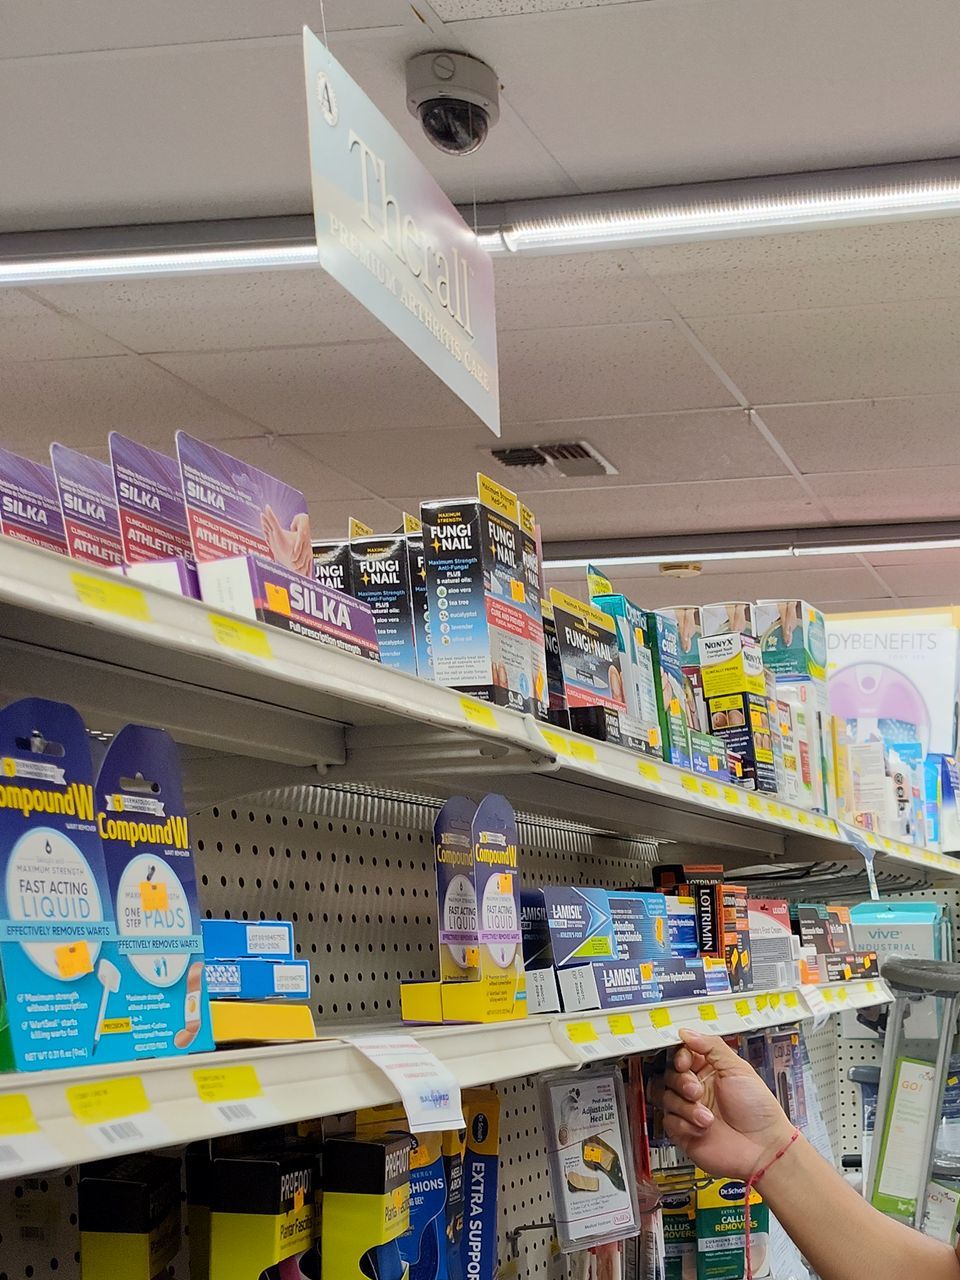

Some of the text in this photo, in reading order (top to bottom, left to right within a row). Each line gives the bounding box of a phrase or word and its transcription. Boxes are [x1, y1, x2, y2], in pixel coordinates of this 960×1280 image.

[349, 128, 475, 340] Therall
[328, 212, 491, 393] PREMIUM ARTHRITIS CARE
[119, 482, 162, 512] SILKA
[187, 481, 226, 511] SILKA
[2, 498, 48, 526] SILKA
[63, 492, 107, 523] SILKA
[430, 524, 472, 539] FUNGI
[488, 520, 516, 551] FUNGI
[127, 529, 184, 558] ATHLETE'S
[441, 537, 472, 552] NAIL
[360, 559, 400, 574] FUNGI
[496, 546, 517, 569] NAIL
[370, 571, 401, 585] NAIL
[289, 582, 353, 631] SILKA
[301, 626, 335, 647] prescription
[335, 637, 362, 656] strength
[565, 626, 613, 663] FUNGI NAIL
[17, 865, 85, 876] MAXIMUM STRENGTH
[19, 879, 88, 896] FAST ACTING
[21, 895, 91, 919] LIQUID
[125, 908, 141, 918] ONE
[497, 906, 513, 917] ACTING
[550, 904, 582, 920] LAMISIL
[126, 917, 142, 928] STEP
[144, 907, 186, 929] PADS
[448, 915, 477, 931] LIQUID
[487, 915, 513, 930] LIQUID
[700, 889, 713, 951] LOTRIMIN
[7, 925, 111, 937] EFFECTIVELY REMOVES WARTS
[868, 928, 903, 940] vive
[151, 939, 199, 949] REMOVES WARTS
[600, 968, 639, 988] LAMISIL
[902, 1079, 923, 1094] GO!
[581, 1104, 614, 1116] Adjustable
[280, 1168, 313, 1203] PROFOOT
[469, 1162, 486, 1217] EXTRA
